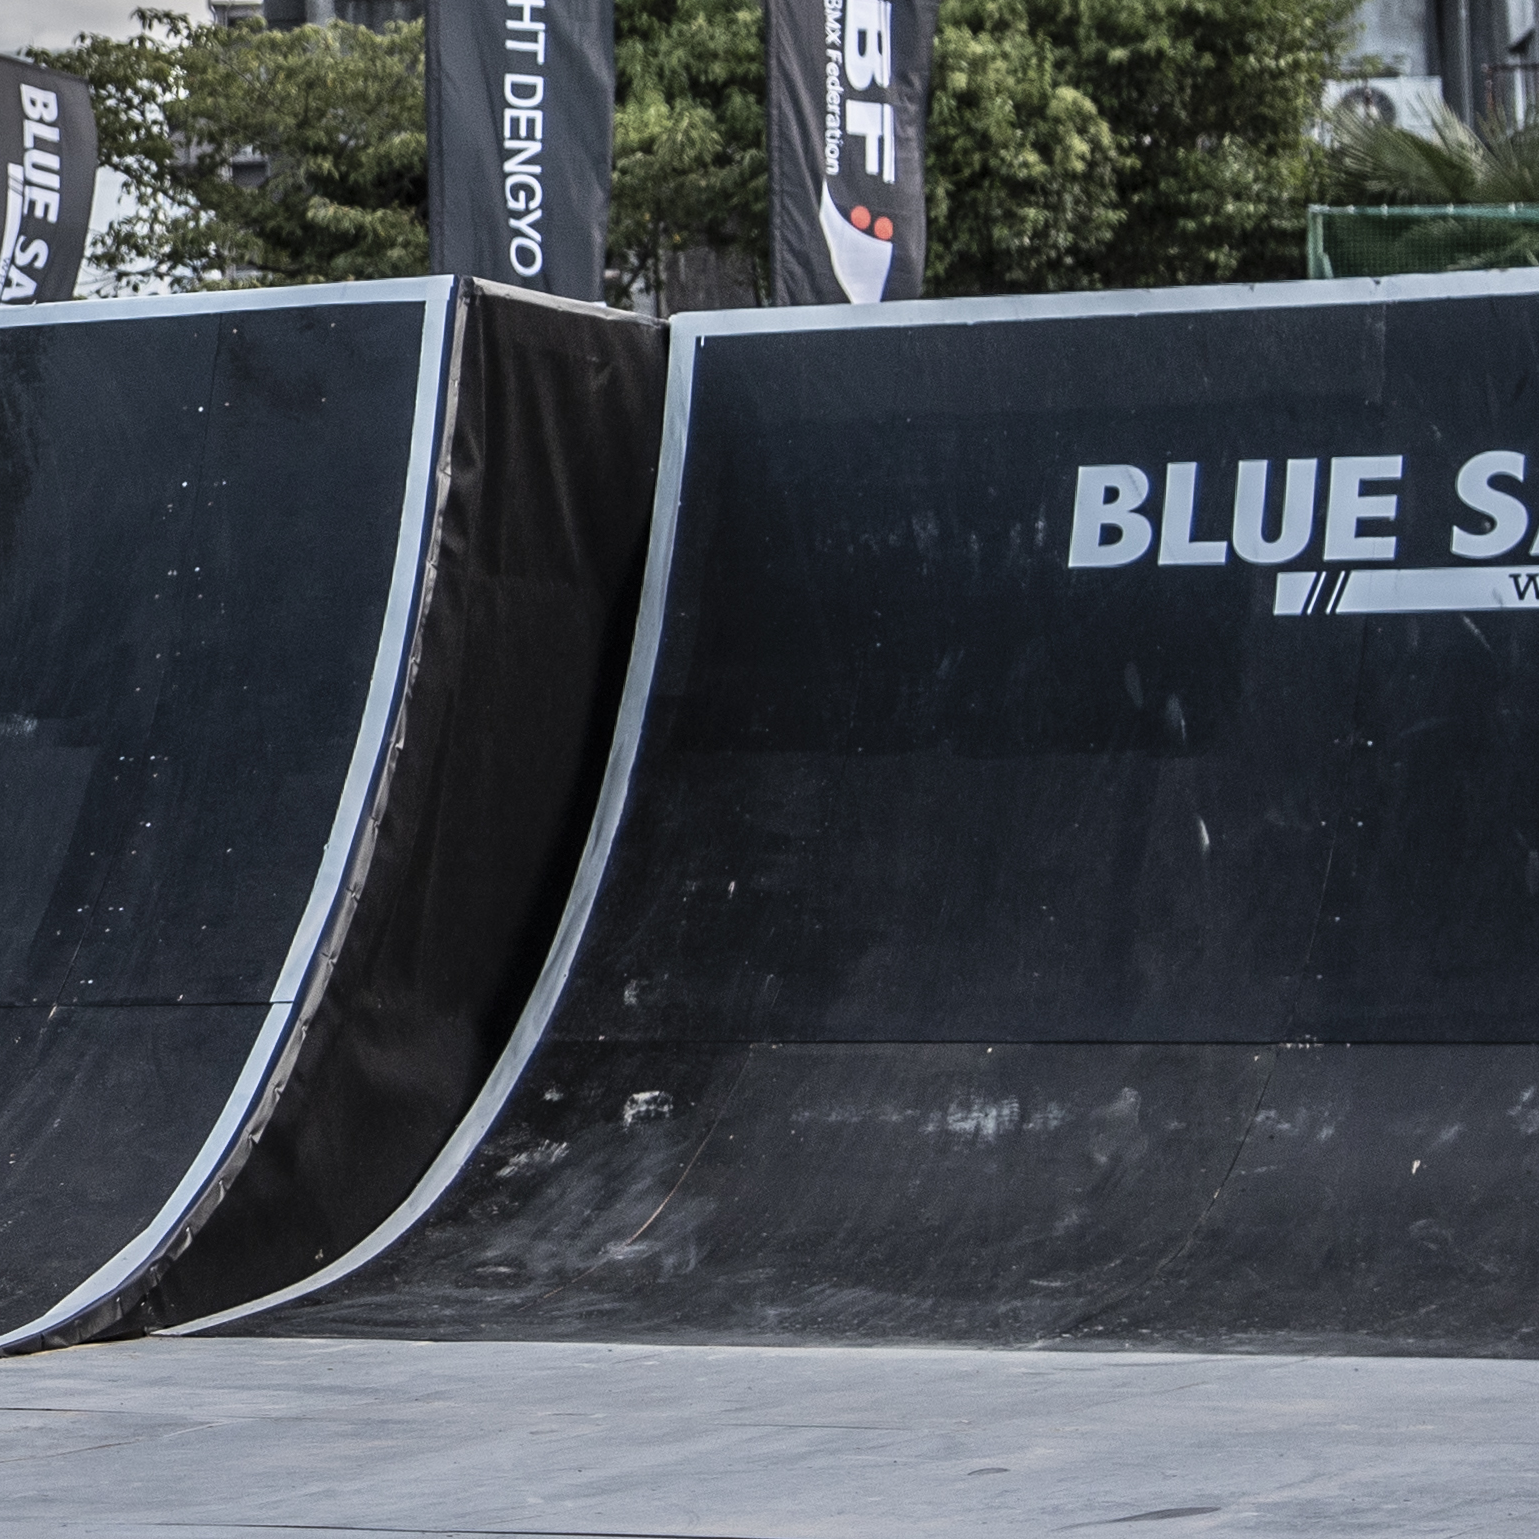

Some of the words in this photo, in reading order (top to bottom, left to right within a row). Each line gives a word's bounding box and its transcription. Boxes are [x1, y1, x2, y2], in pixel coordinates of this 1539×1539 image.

[20, 83, 60, 225] BLUE
[502, 72, 544, 278] DENGYO
[823, 53, 843, 176] Federation
[1, 235, 49, 302] SA
[1068, 454, 1403, 569] BLUE
[1450, 449, 1539, 560] S
